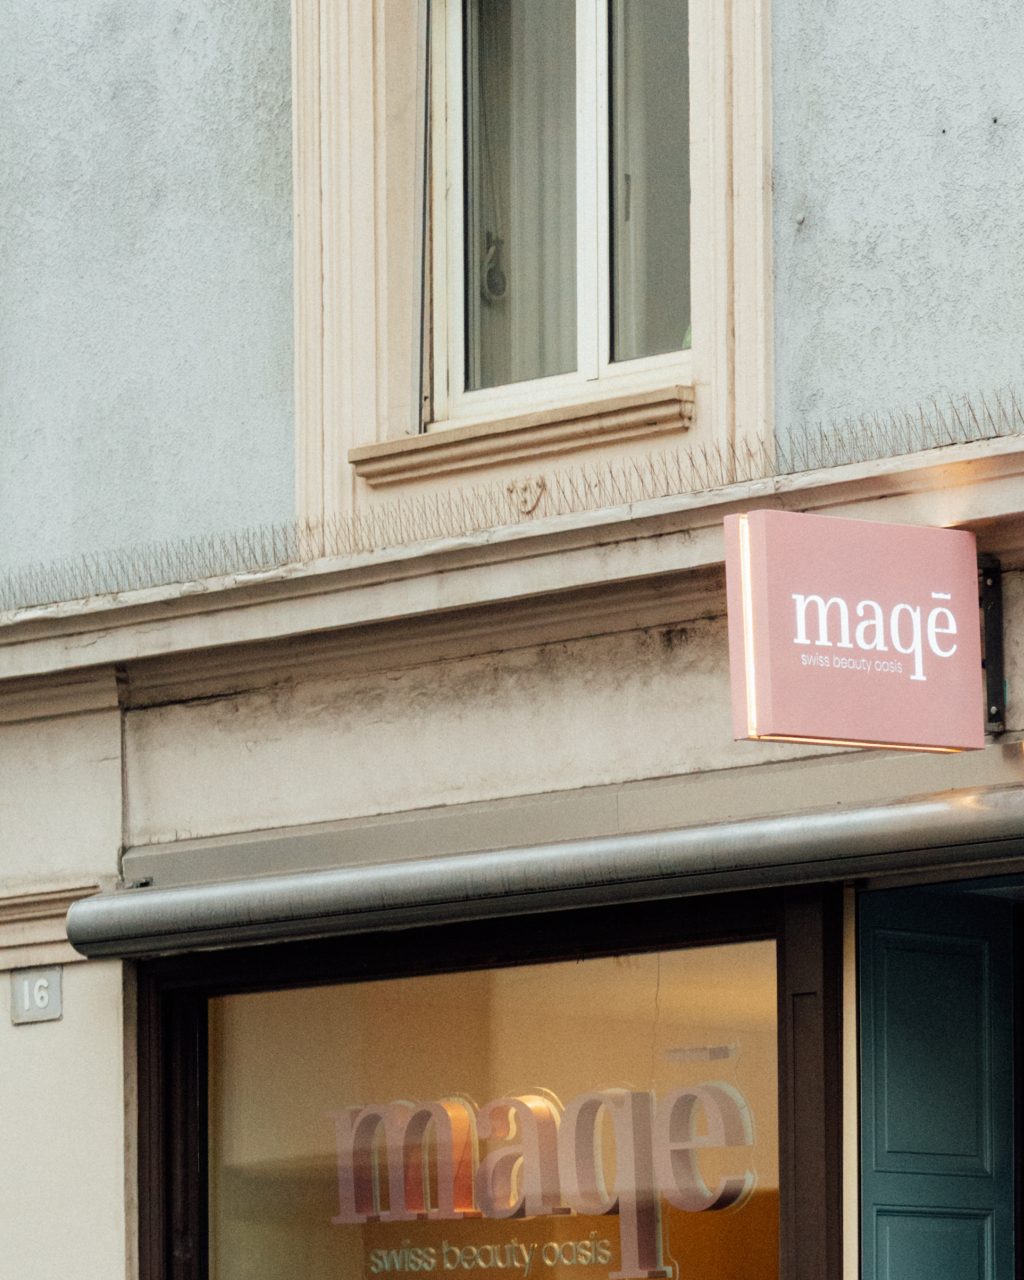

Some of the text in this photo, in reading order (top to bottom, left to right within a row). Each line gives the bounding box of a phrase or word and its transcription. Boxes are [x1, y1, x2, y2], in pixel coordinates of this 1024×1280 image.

[792, 592, 957, 680] maqē
[801, 653, 903, 674] swiss beauty oasis
[24, 978, 49, 1011] 16
[331, 1041, 755, 1280] maqē
[369, 1231, 613, 1277] swiss beauty oasis
